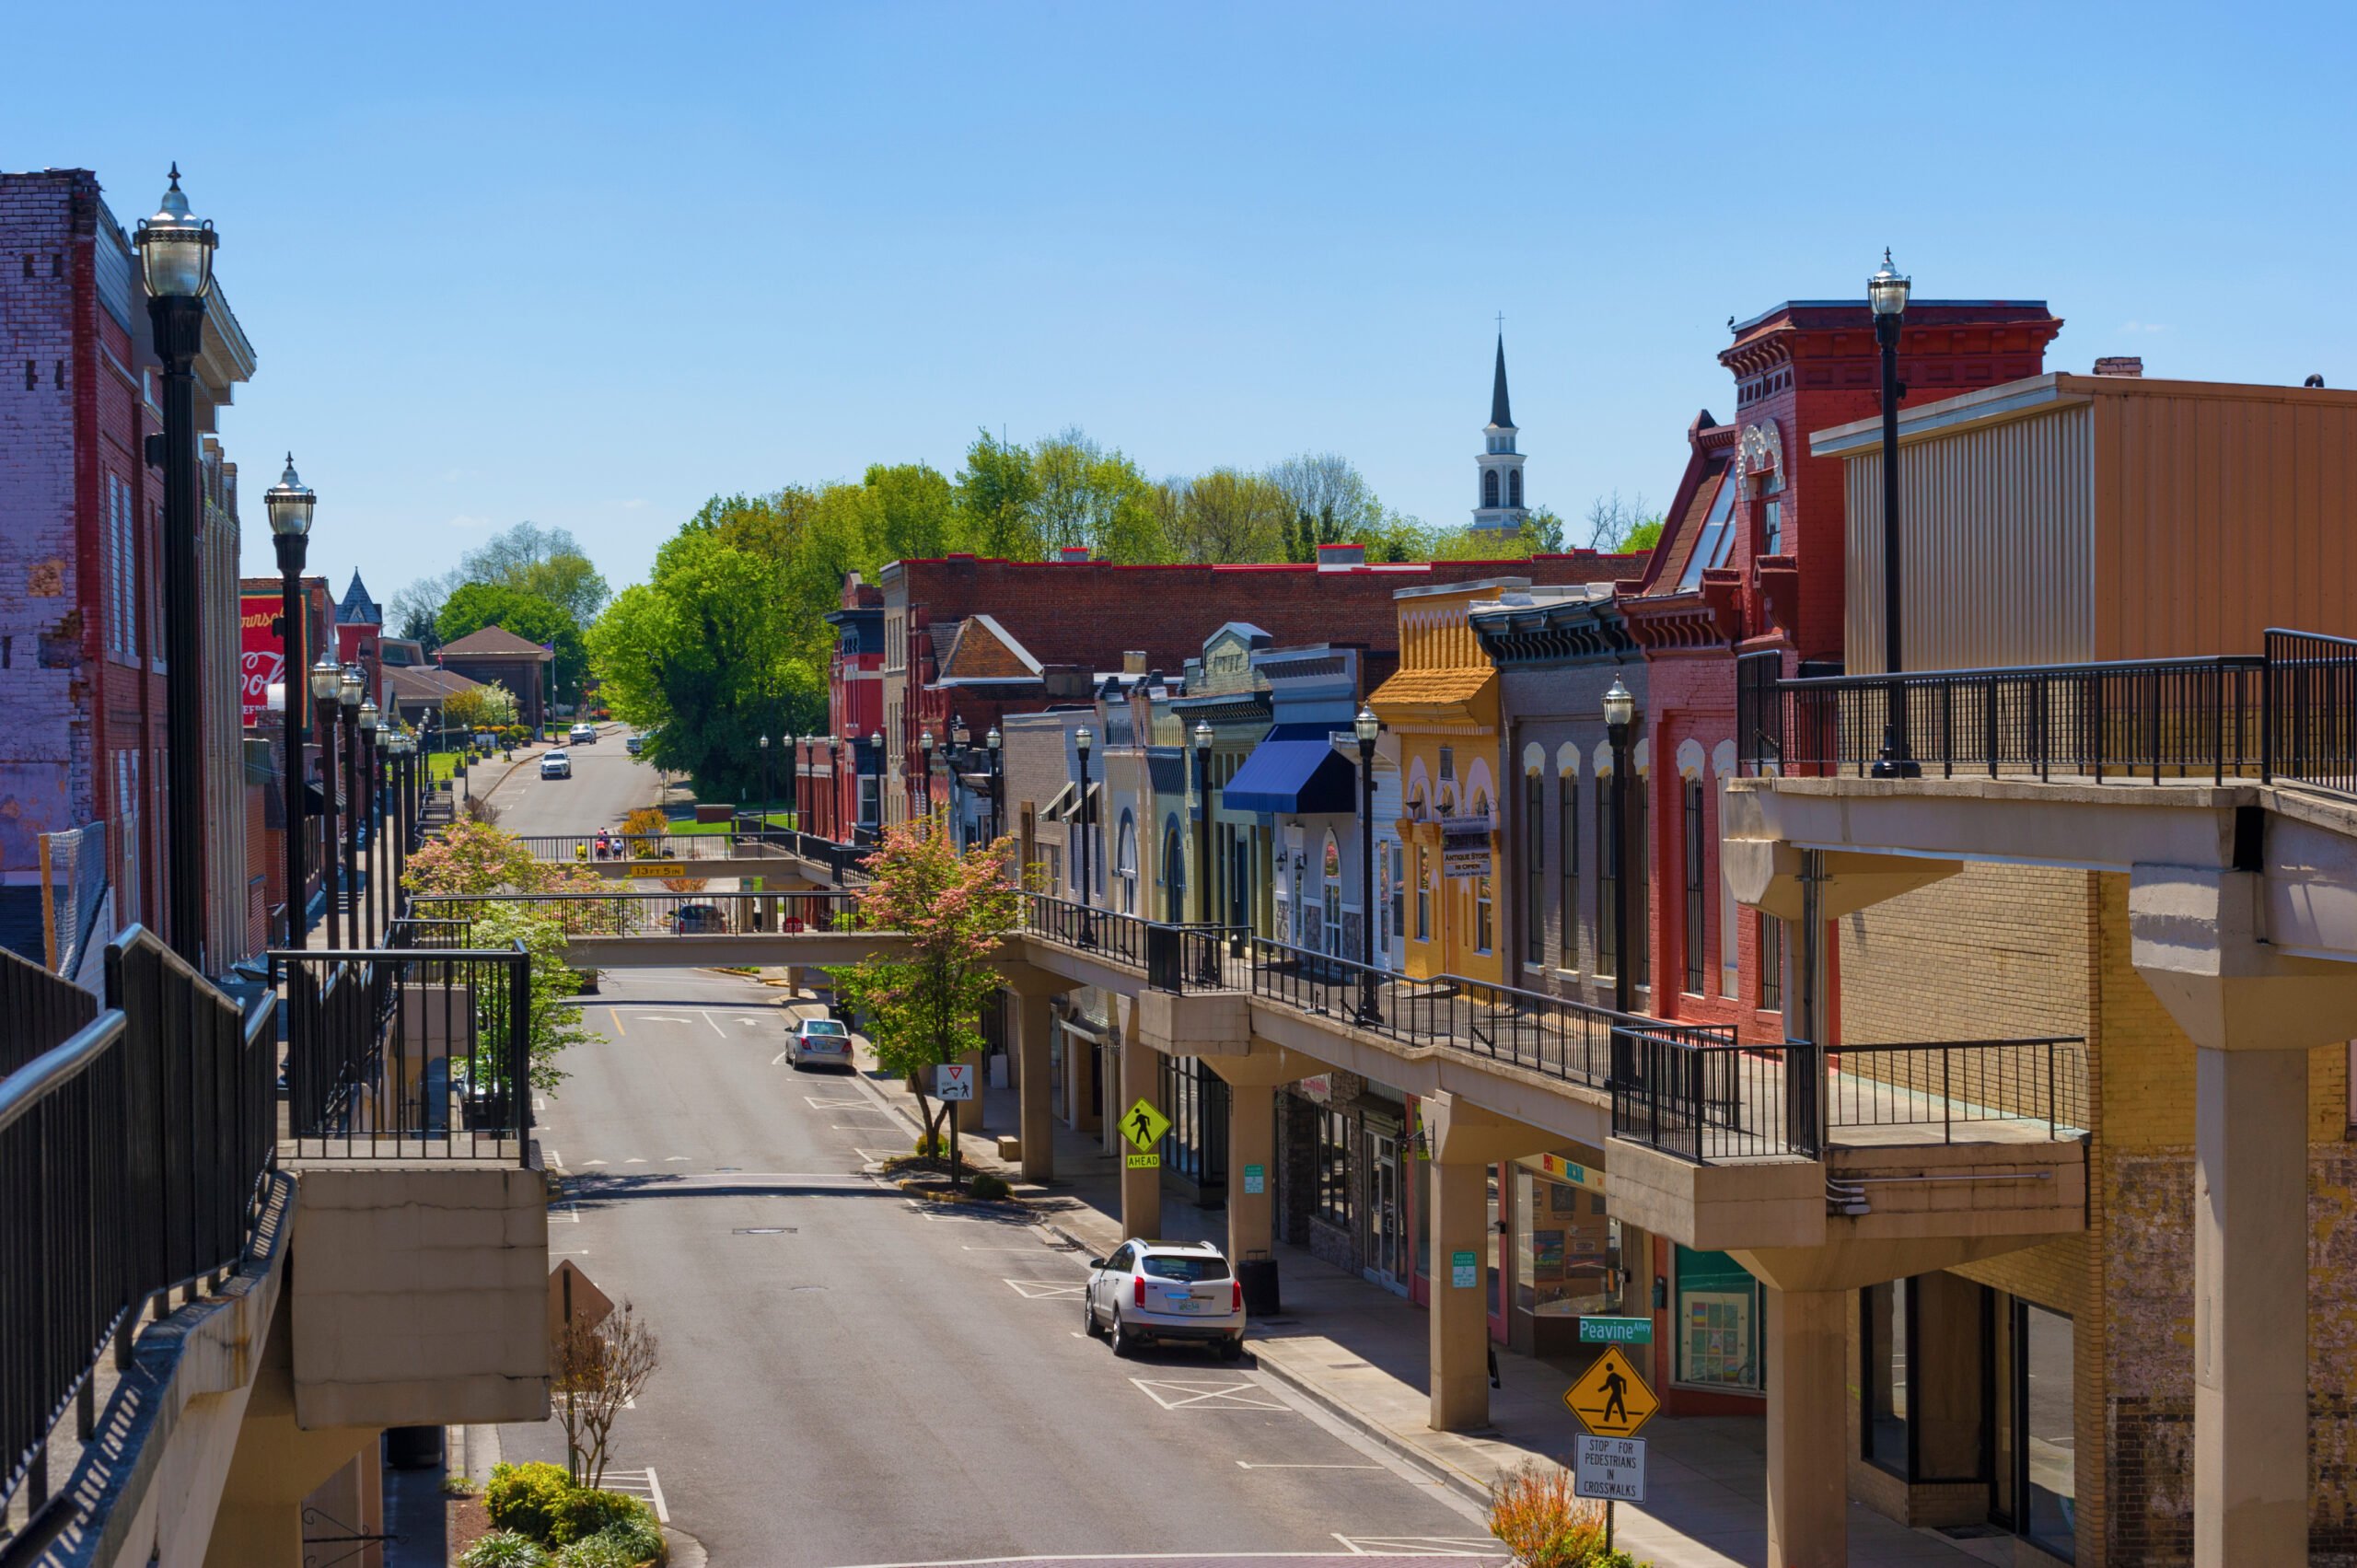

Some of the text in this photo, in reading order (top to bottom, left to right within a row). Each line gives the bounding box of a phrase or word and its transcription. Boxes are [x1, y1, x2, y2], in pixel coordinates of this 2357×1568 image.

[1445, 854, 1470, 862] ANTIQUE
[1129, 1156, 1158, 1167] AHEAD
[1580, 1320, 1652, 1340] Peavine Alley
[1589, 1439, 1633, 1455] STOP FOR
[1585, 1453, 1636, 1469] PEDESTRIANS
[1607, 1469, 1614, 1481] IN
[1584, 1481, 1636, 1497] CROSSWALKS
